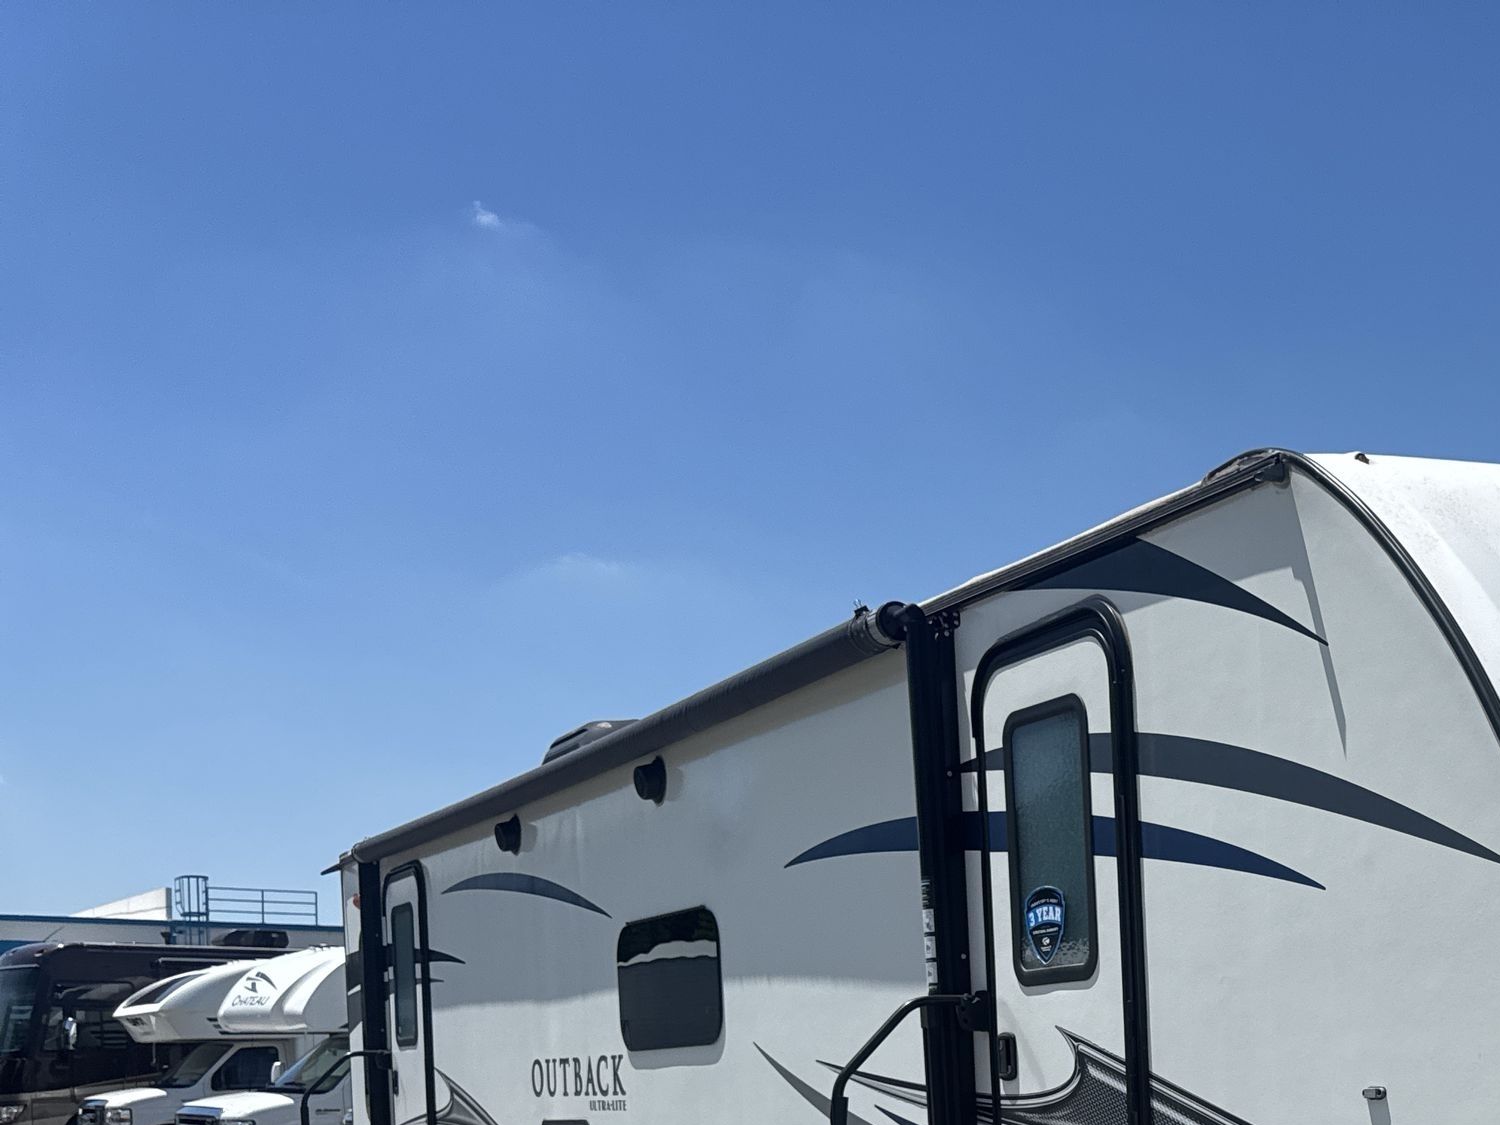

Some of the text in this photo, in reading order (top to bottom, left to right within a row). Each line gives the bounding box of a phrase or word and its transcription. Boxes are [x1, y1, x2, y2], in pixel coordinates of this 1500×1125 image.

[1028, 905, 1061, 927] 3 YEAR
[231, 995, 270, 1007] CHATEAU
[531, 1054, 627, 1098] OUTBACK
[589, 1099, 628, 1112] ULTRA-LITE
